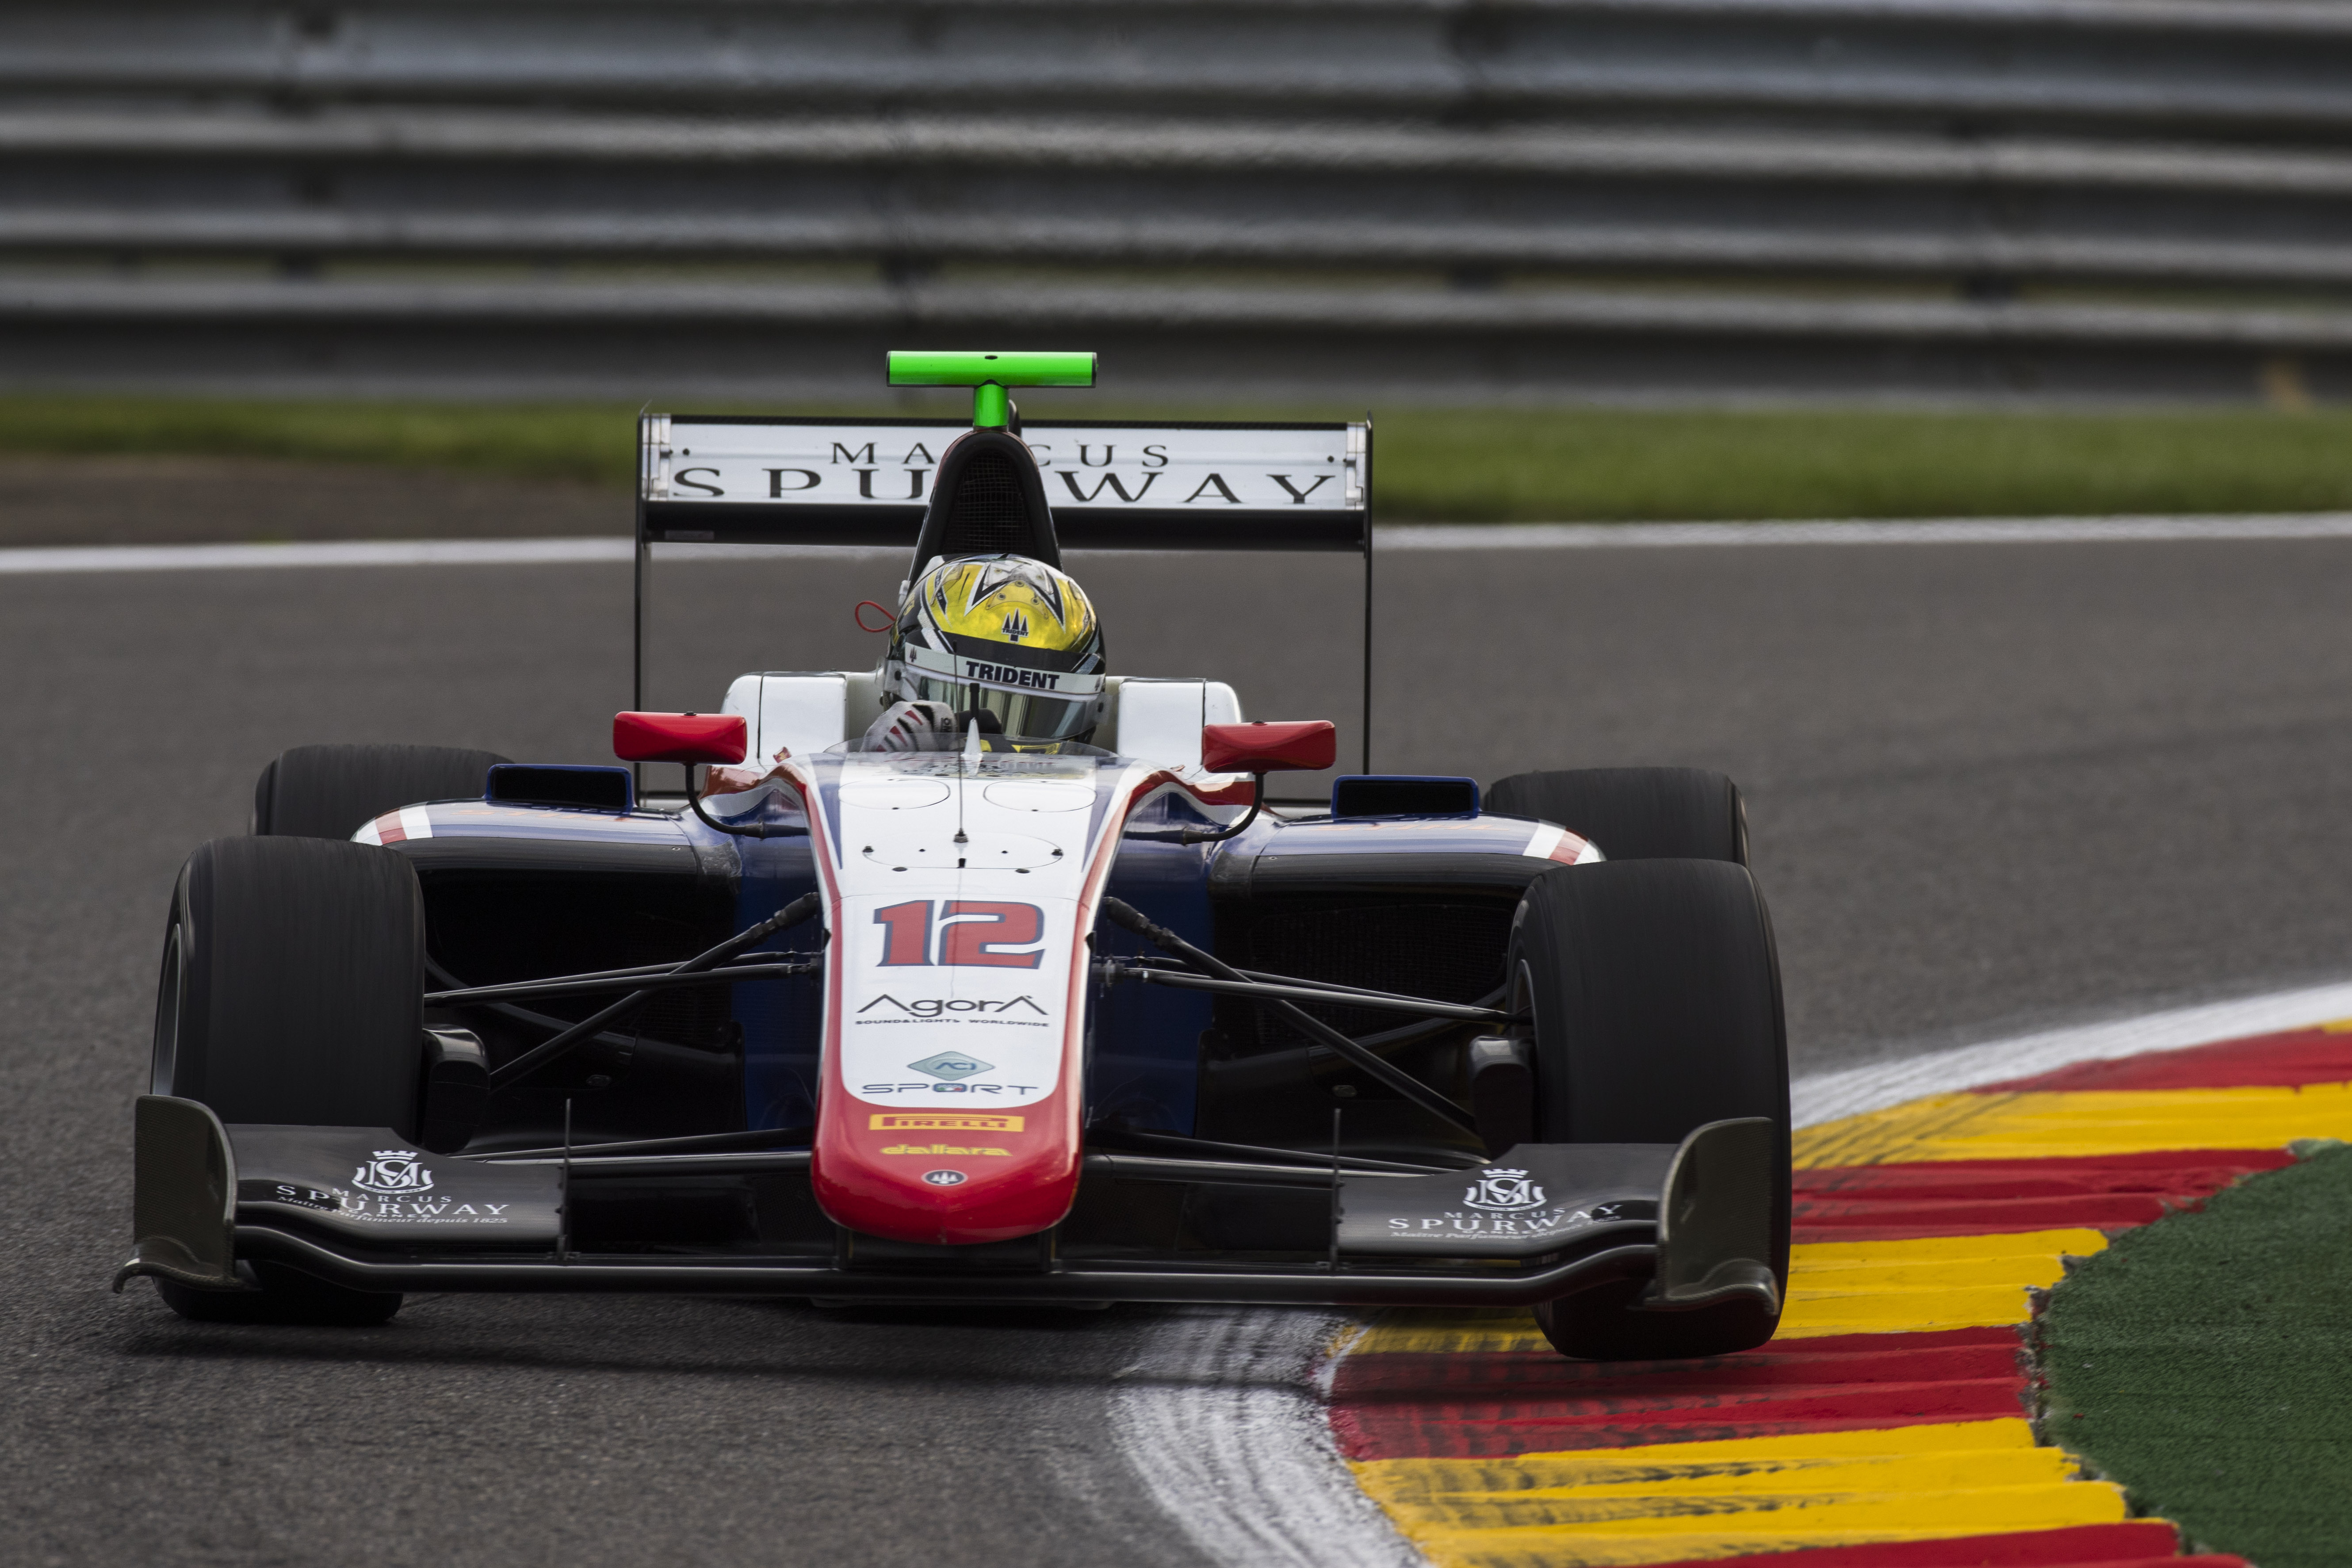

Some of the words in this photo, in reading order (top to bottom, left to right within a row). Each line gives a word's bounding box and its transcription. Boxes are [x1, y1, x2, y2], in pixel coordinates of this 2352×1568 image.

[831, 442, 1169, 467] MACUS
[673, 467, 1336, 505] SPUWAY
[966, 661, 1059, 689] TRIDENT
[873, 899, 1046, 969] 12
[862, 1083, 1039, 1095] SPORT
[882, 1117, 1010, 1128] PIRELLI
[880, 1144, 1013, 1156] dallara
[276, 1186, 509, 1215] SPURWAY
[332, 1188, 452, 1202] MARCUS
[1388, 1205, 1623, 1231] SPURWAY
[1444, 1208, 1565, 1219] MARCUS
